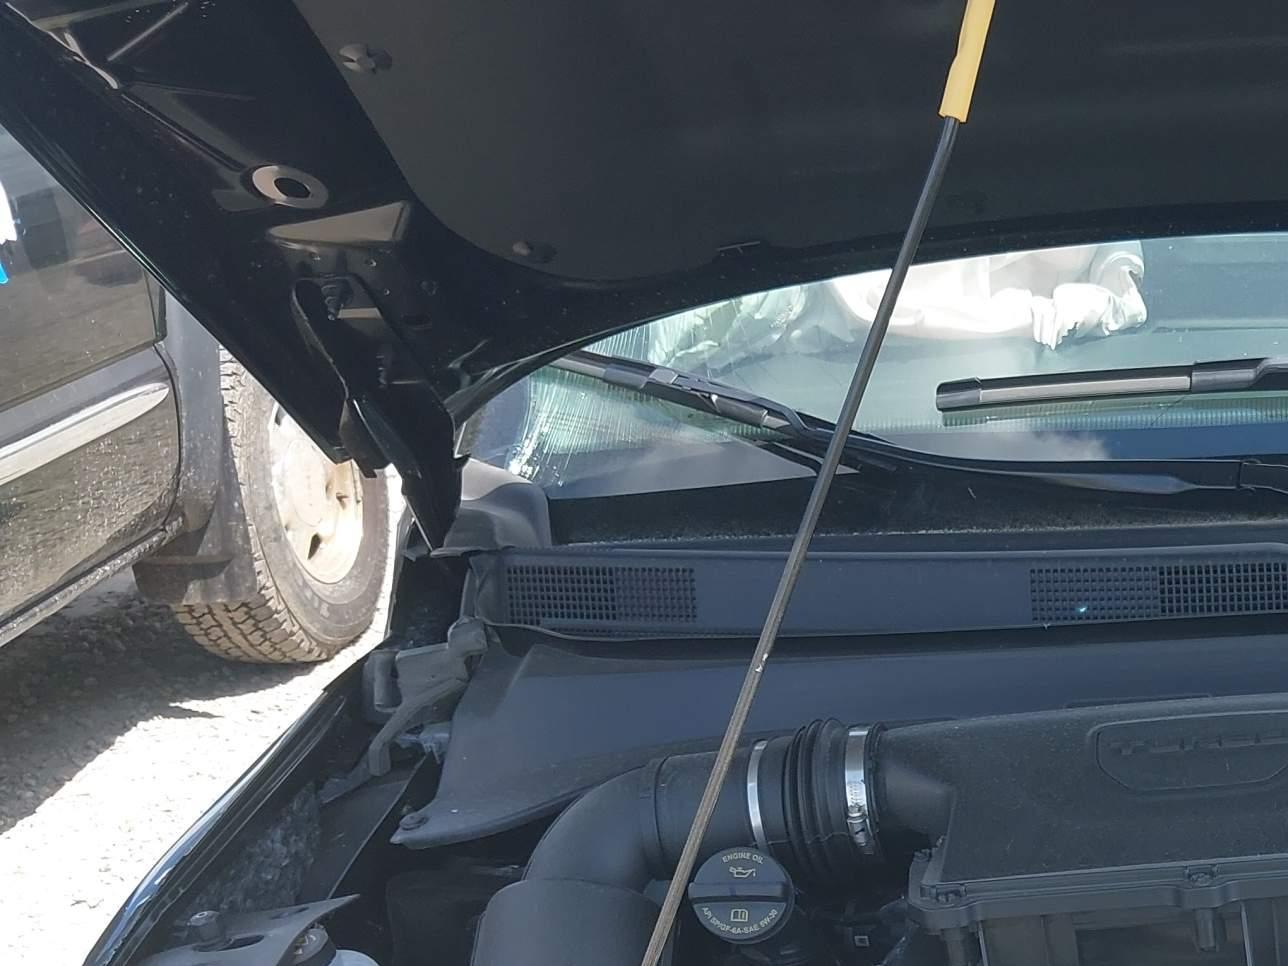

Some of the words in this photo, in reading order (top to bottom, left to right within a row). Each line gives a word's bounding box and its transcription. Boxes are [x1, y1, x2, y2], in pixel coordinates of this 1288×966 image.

[722, 852, 751, 863] ENGINE
[752, 854, 764, 864] OIL
[702, 907, 712, 920] API
